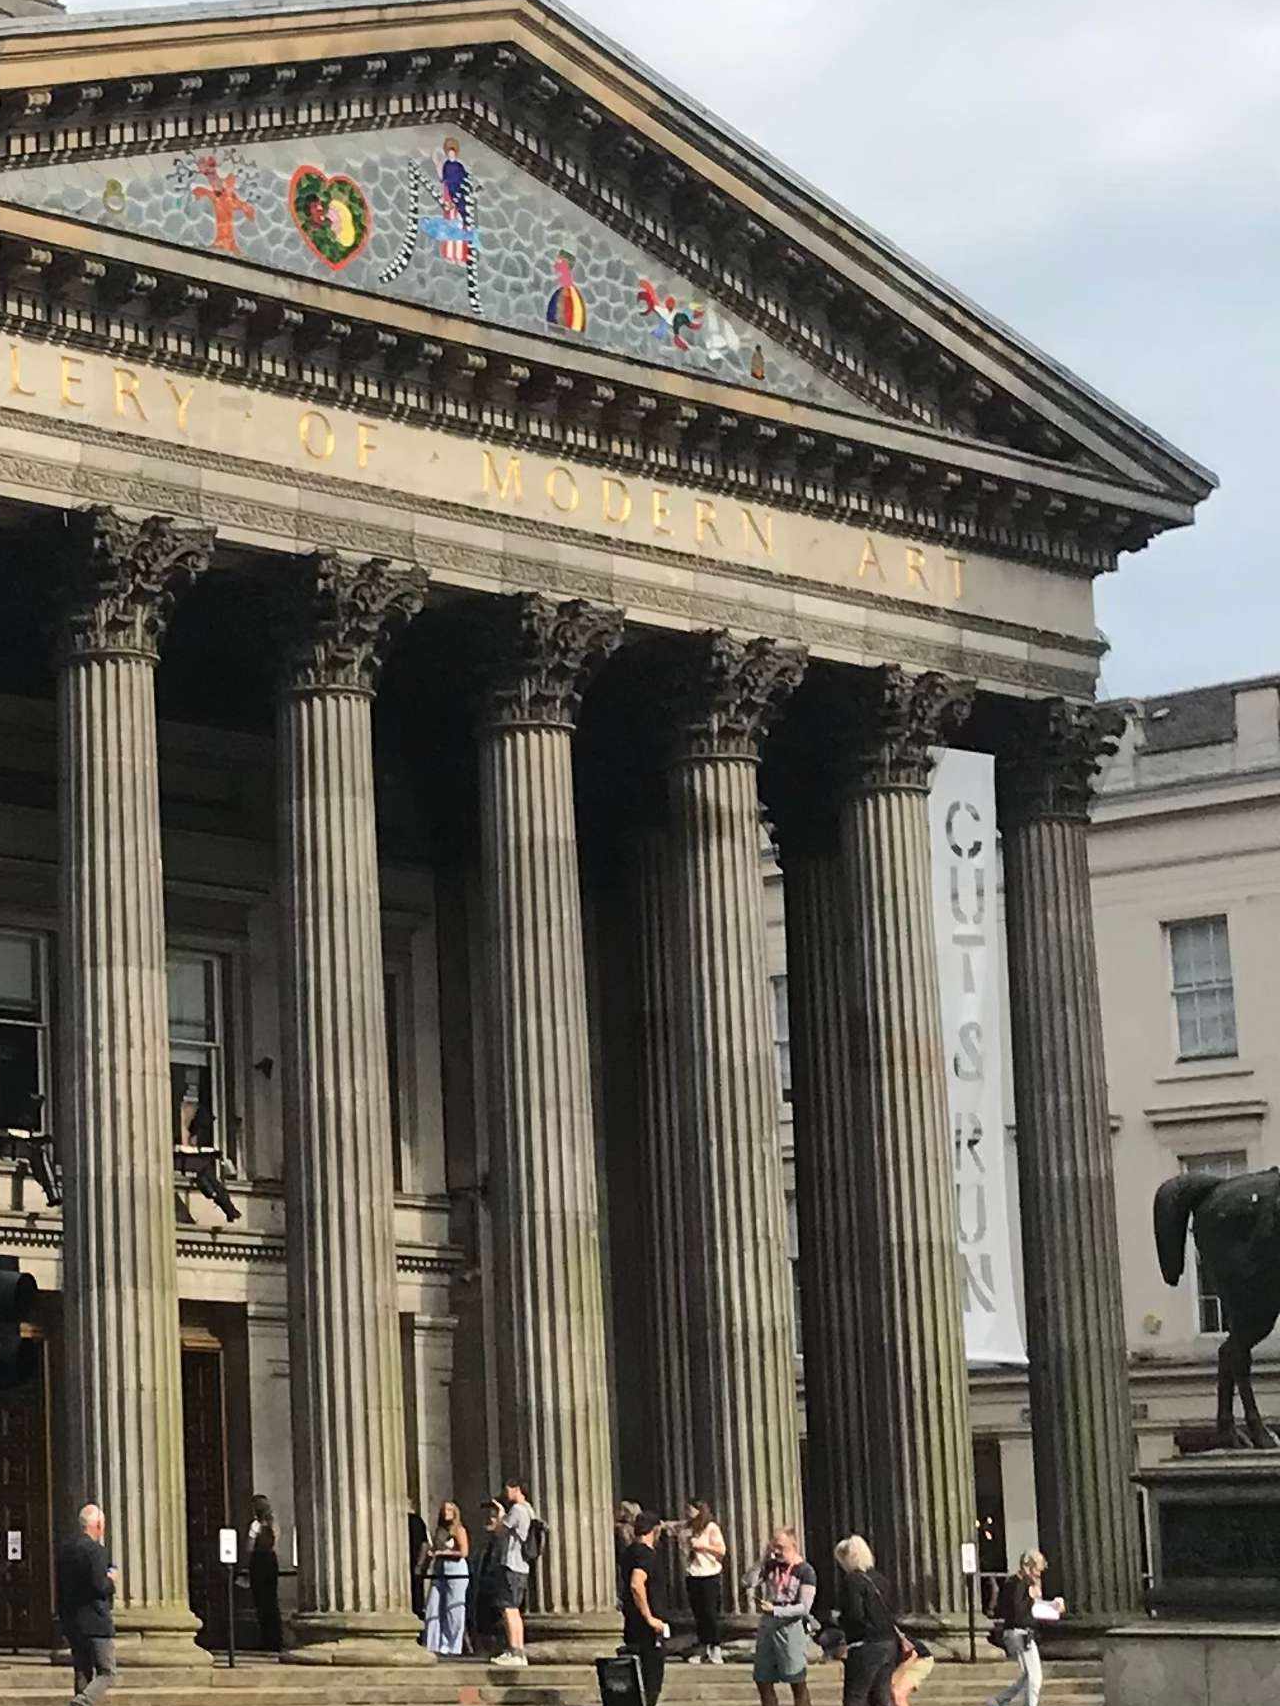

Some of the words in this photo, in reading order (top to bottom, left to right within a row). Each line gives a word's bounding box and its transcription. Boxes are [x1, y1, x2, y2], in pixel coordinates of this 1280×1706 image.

[297, 409, 379, 470] OF
[480, 449, 777, 558] MODERN
[857, 535, 968, 600] ART
[945, 800, 986, 995] CUT
[954, 1112, 998, 1315] RUN
